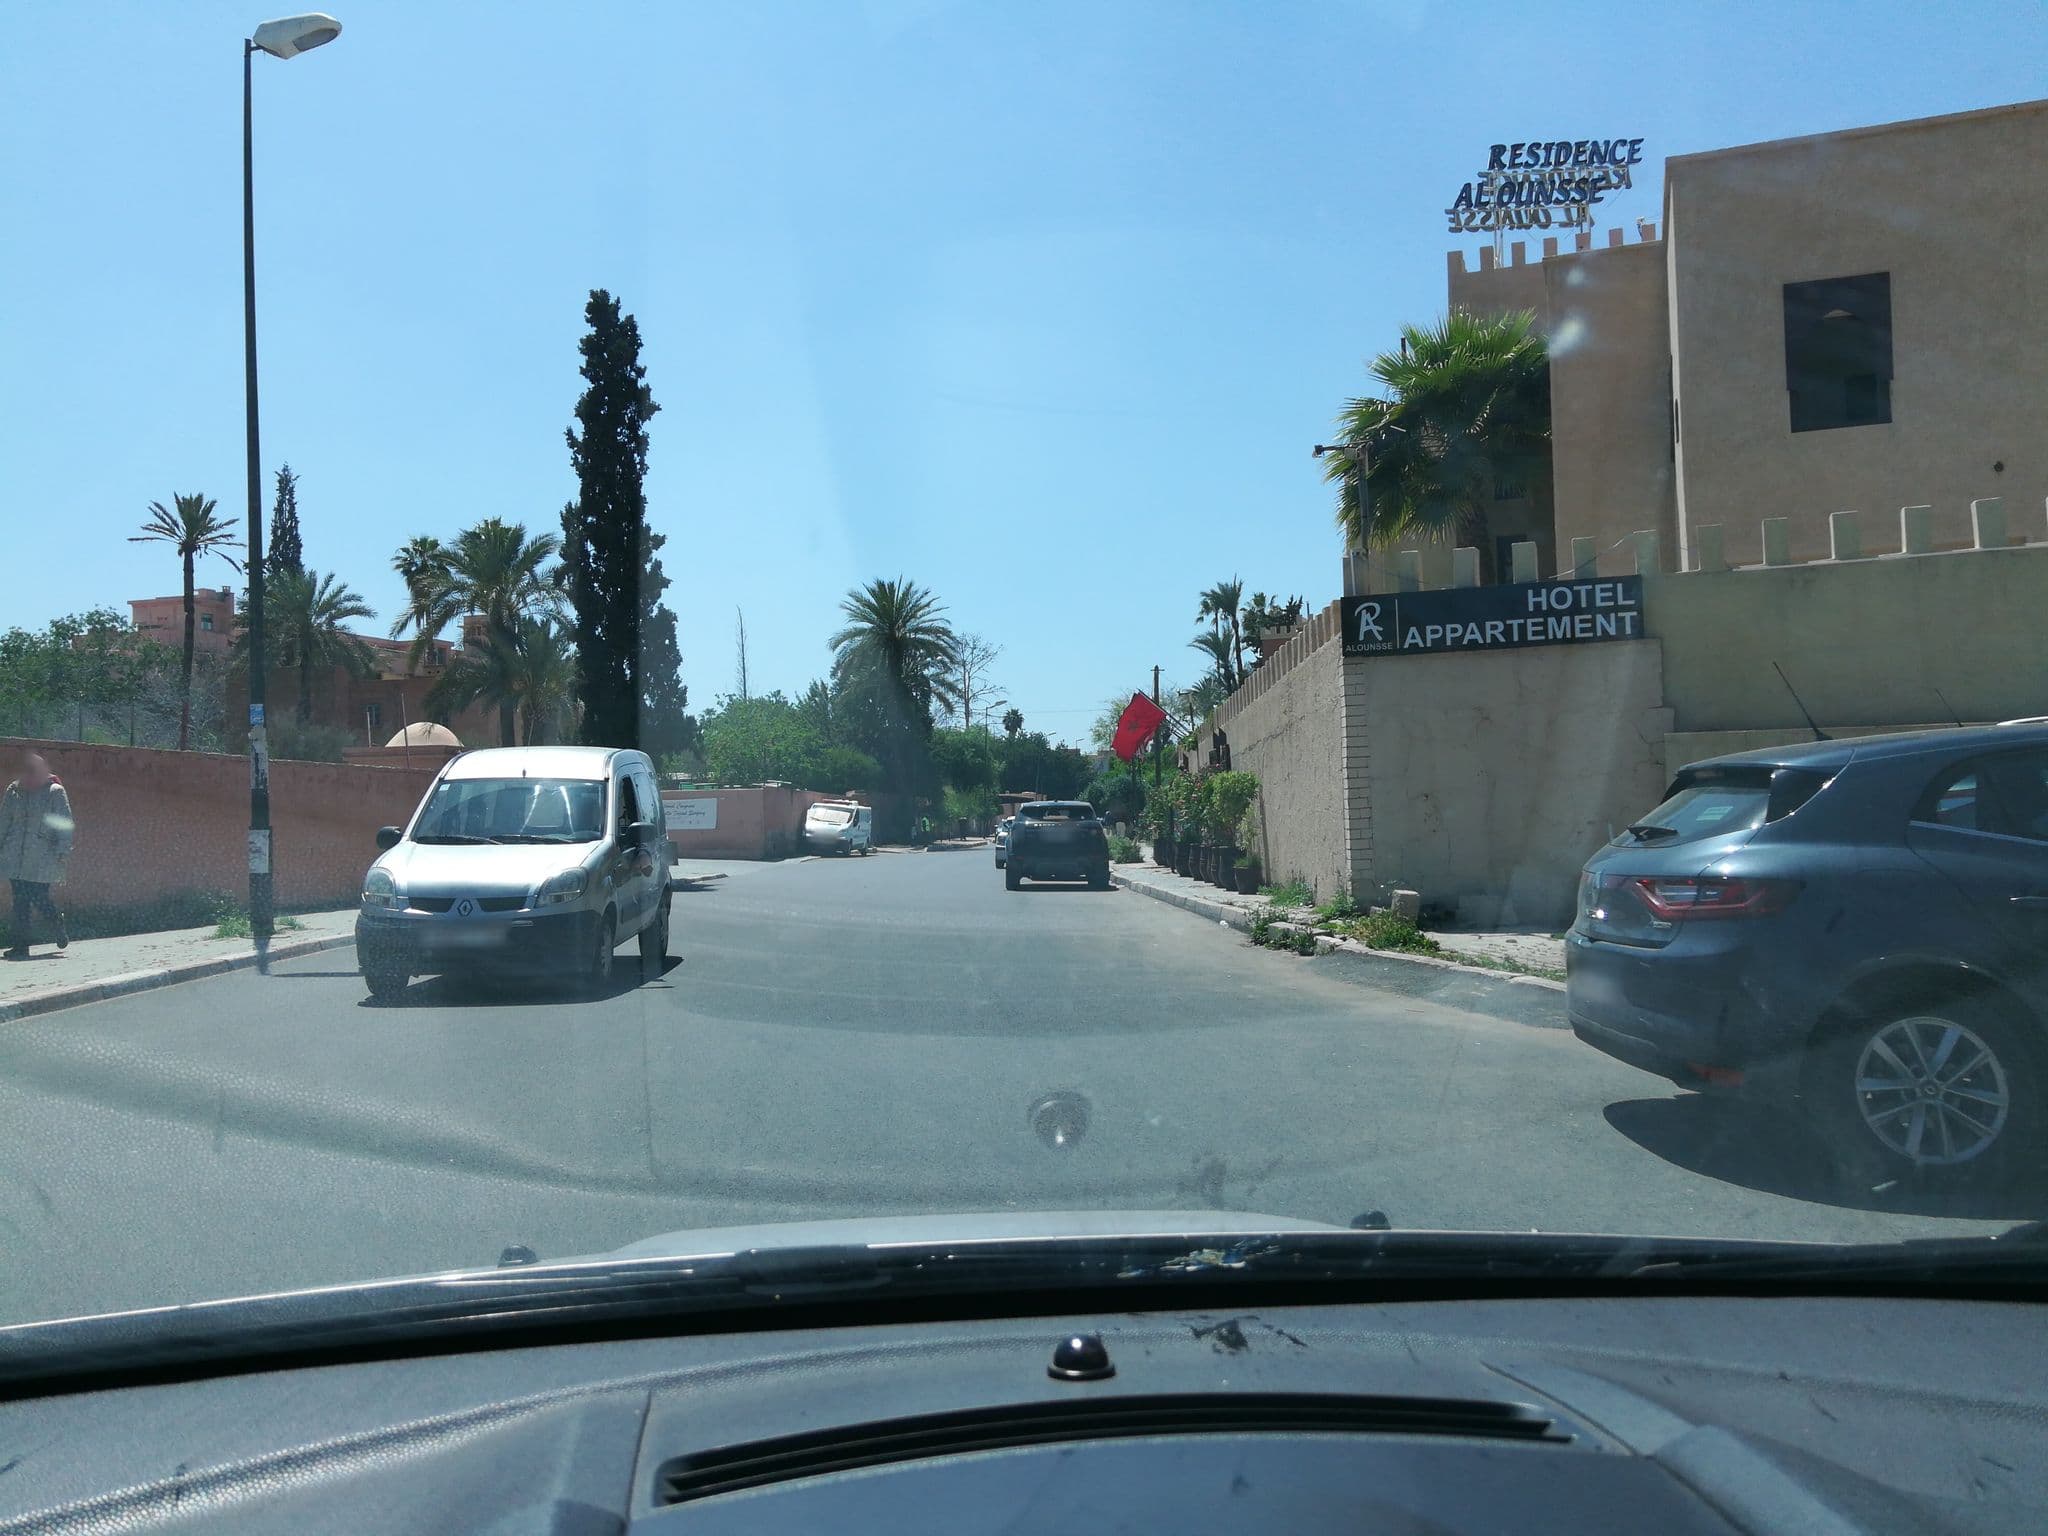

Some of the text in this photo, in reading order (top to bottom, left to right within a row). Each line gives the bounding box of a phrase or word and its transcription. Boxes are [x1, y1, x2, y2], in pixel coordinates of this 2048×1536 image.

[1488, 138, 1644, 171] RESIDENCE
[1527, 582, 1636, 612] HOTEL
[1403, 611, 1638, 649] APPARTEMENT
[1344, 641, 1394, 653] ALOUNSSE
